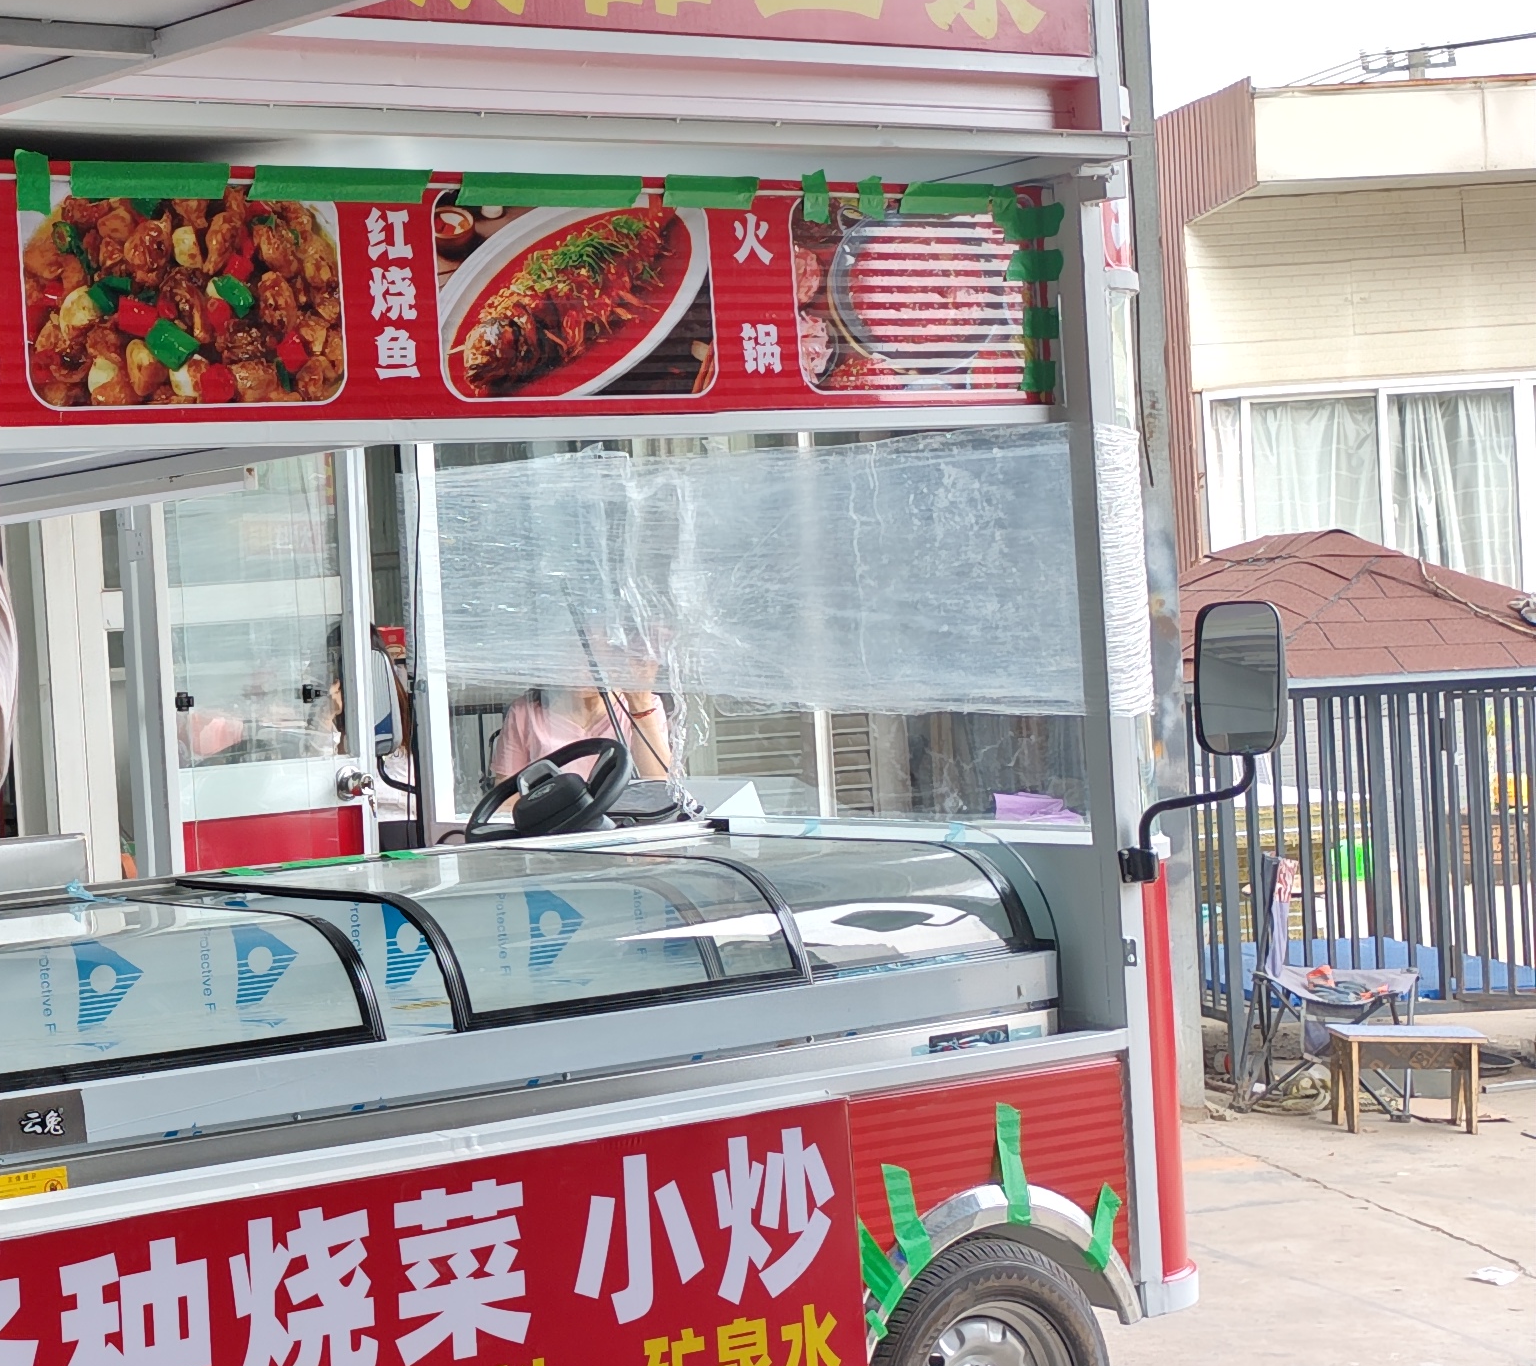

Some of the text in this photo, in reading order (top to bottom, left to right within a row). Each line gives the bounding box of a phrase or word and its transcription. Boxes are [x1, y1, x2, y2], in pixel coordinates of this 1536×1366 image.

[366, 206, 421, 381] 红烧鱼
[733, 211, 783, 376] 火锅
[37, 946, 54, 1018] otective
[574, 1126, 837, 1325] 小炒
